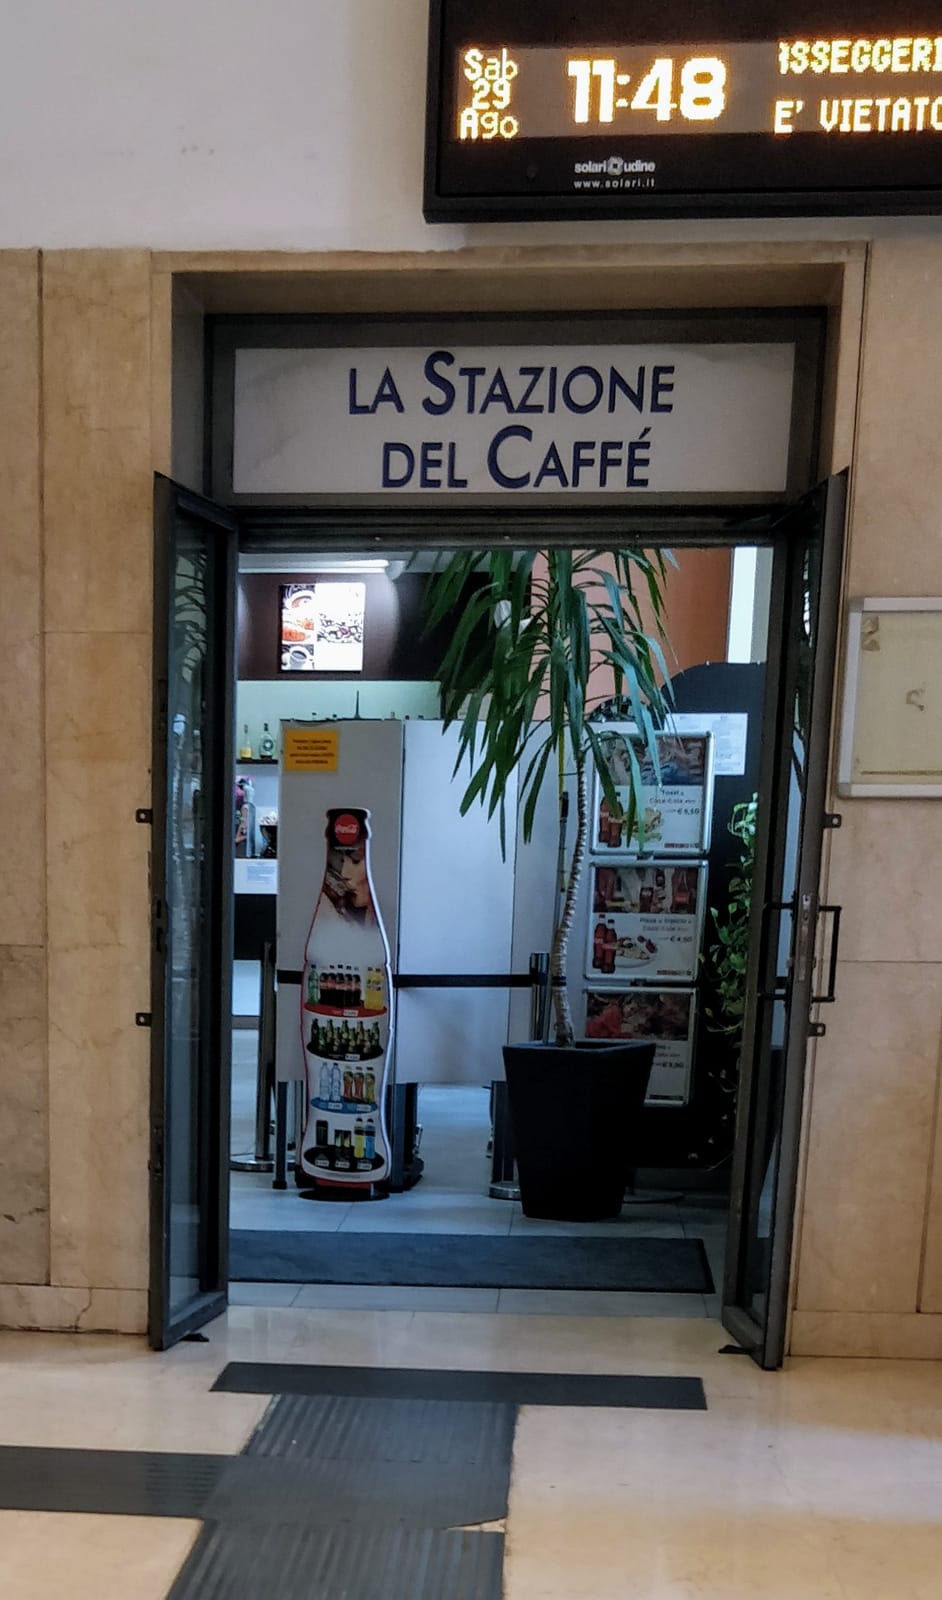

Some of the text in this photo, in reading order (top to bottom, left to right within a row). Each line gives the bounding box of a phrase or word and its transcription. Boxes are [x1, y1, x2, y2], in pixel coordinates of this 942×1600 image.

[464, 48, 518, 80] Sab
[472, 78, 511, 109] 29
[568, 57, 727, 123] 11:48
[460, 108, 518, 139] Ago
[774, 100, 803, 134] E'
[574, 160, 656, 173] solari udine
[574, 178, 655, 188] www.solari.it
[349, 350, 675, 416] LA STAZIONE
[382, 424, 652, 489] DEL CAFFÉ
